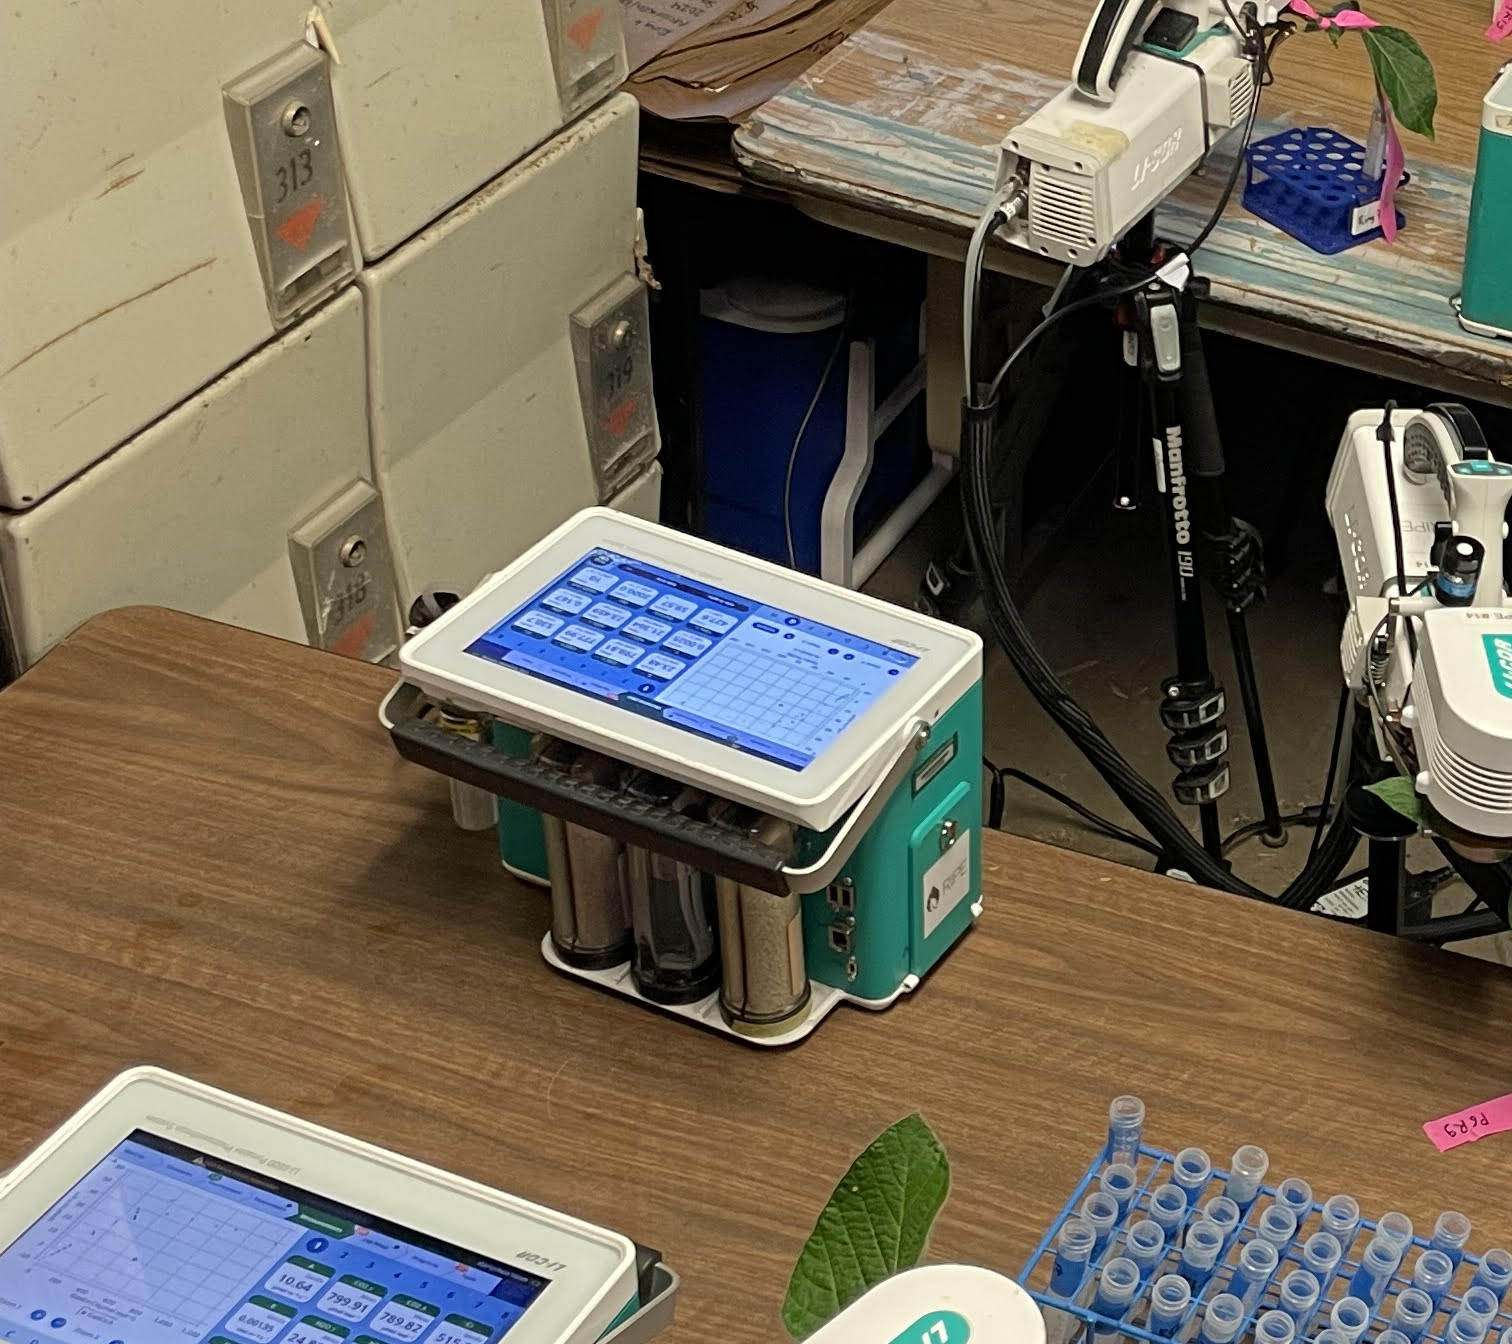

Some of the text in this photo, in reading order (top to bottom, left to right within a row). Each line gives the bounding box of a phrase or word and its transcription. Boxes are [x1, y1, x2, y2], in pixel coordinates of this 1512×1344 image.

[276, 148, 313, 203] 313
[1166, 425, 1191, 545] Manfrotto
[278, 1273, 312, 1293] 10.64
[327, 1290, 369, 1314] 799.91
[378, 1310, 423, 1335] 789.82
